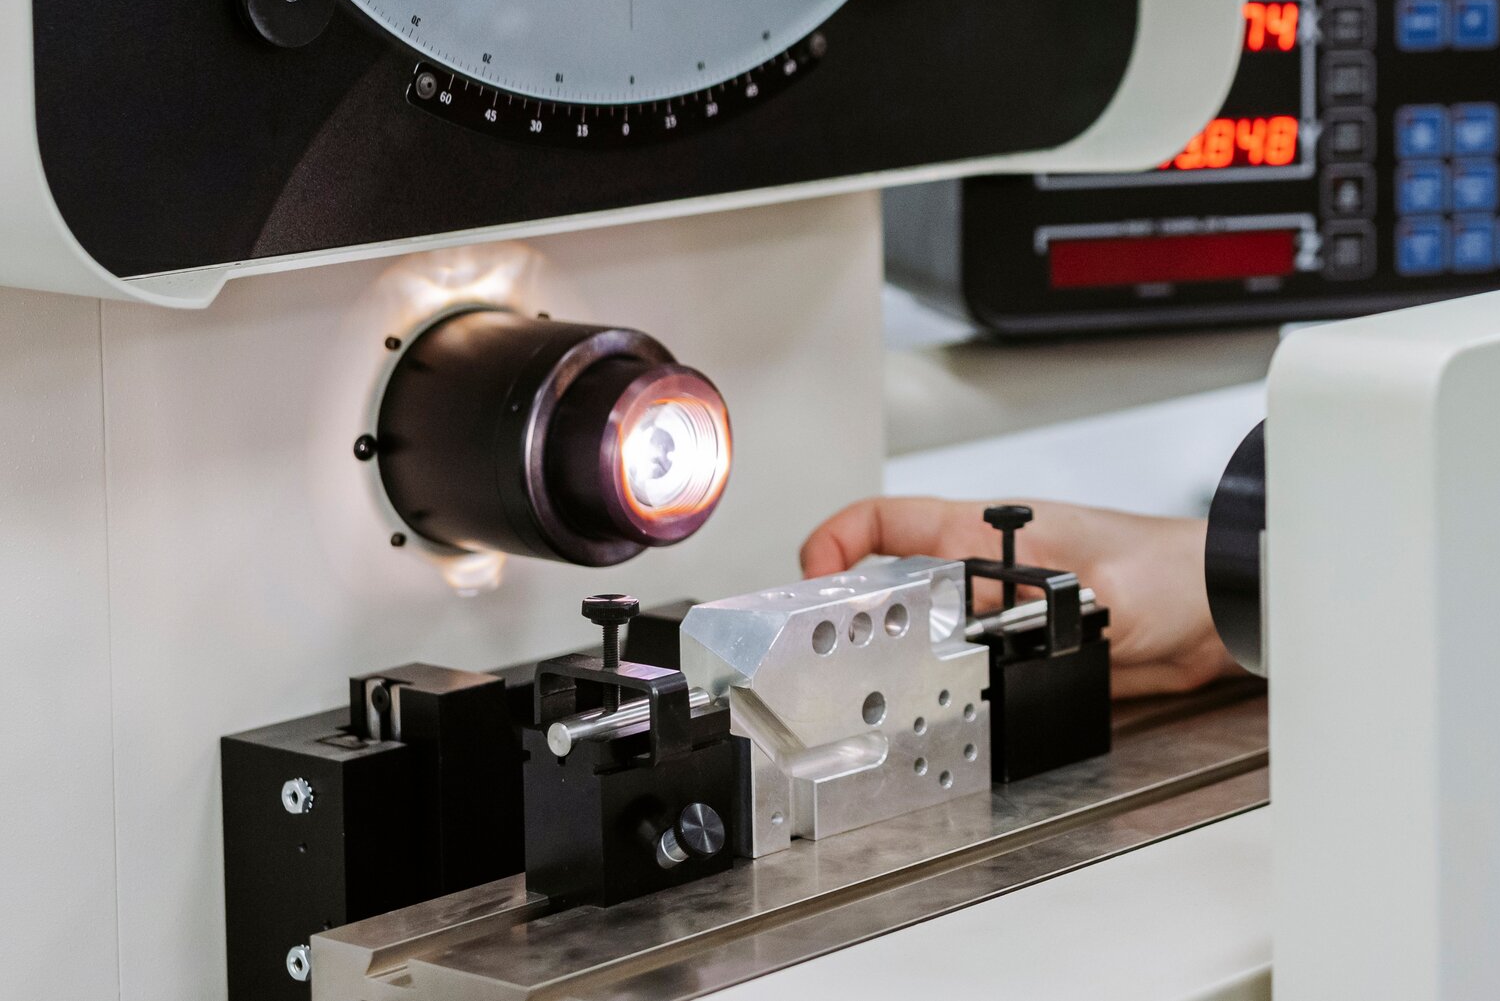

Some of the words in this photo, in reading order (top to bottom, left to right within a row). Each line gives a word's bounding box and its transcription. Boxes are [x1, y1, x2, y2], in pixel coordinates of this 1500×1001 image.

[410, 14, 422, 28] 30
[482, 52, 493, 65] 20
[439, 90, 453, 105] 60
[484, 108, 498, 122] 45
[529, 119, 543, 134] 30
[576, 123, 589, 138] 15
[622, 122, 630, 136] 0
